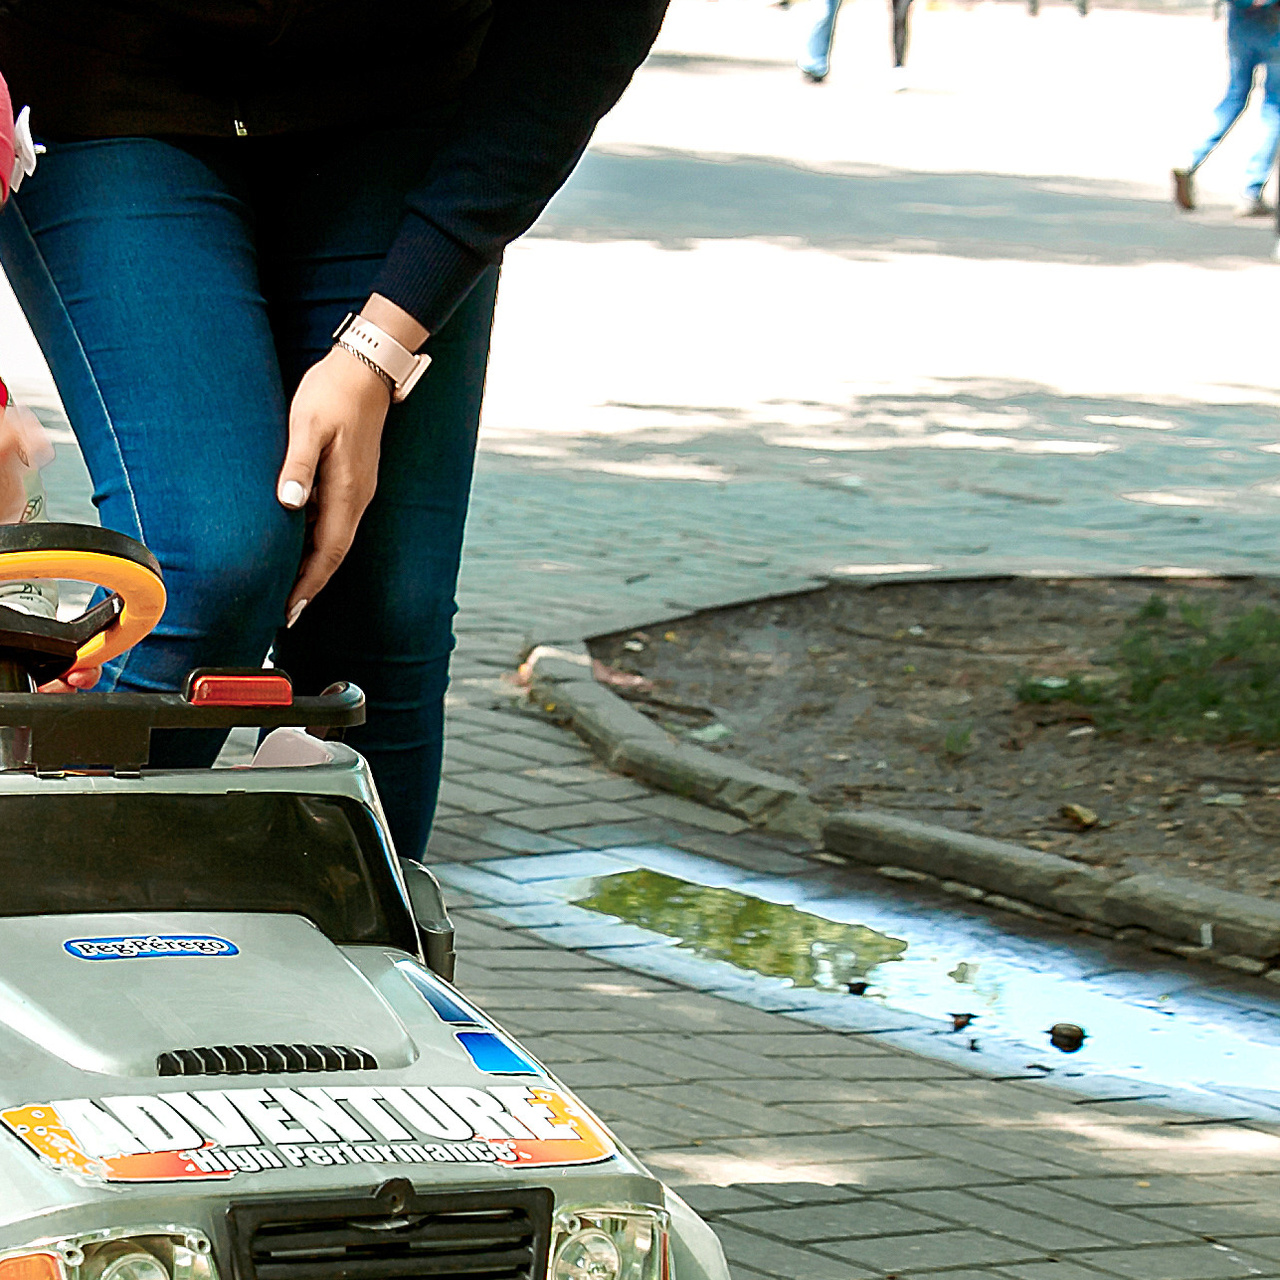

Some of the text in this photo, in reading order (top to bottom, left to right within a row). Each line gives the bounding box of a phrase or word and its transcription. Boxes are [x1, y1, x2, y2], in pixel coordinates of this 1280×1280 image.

[50, 1086, 583, 1158] ADVENTURE
[187, 1140, 519, 1173] High Performance
